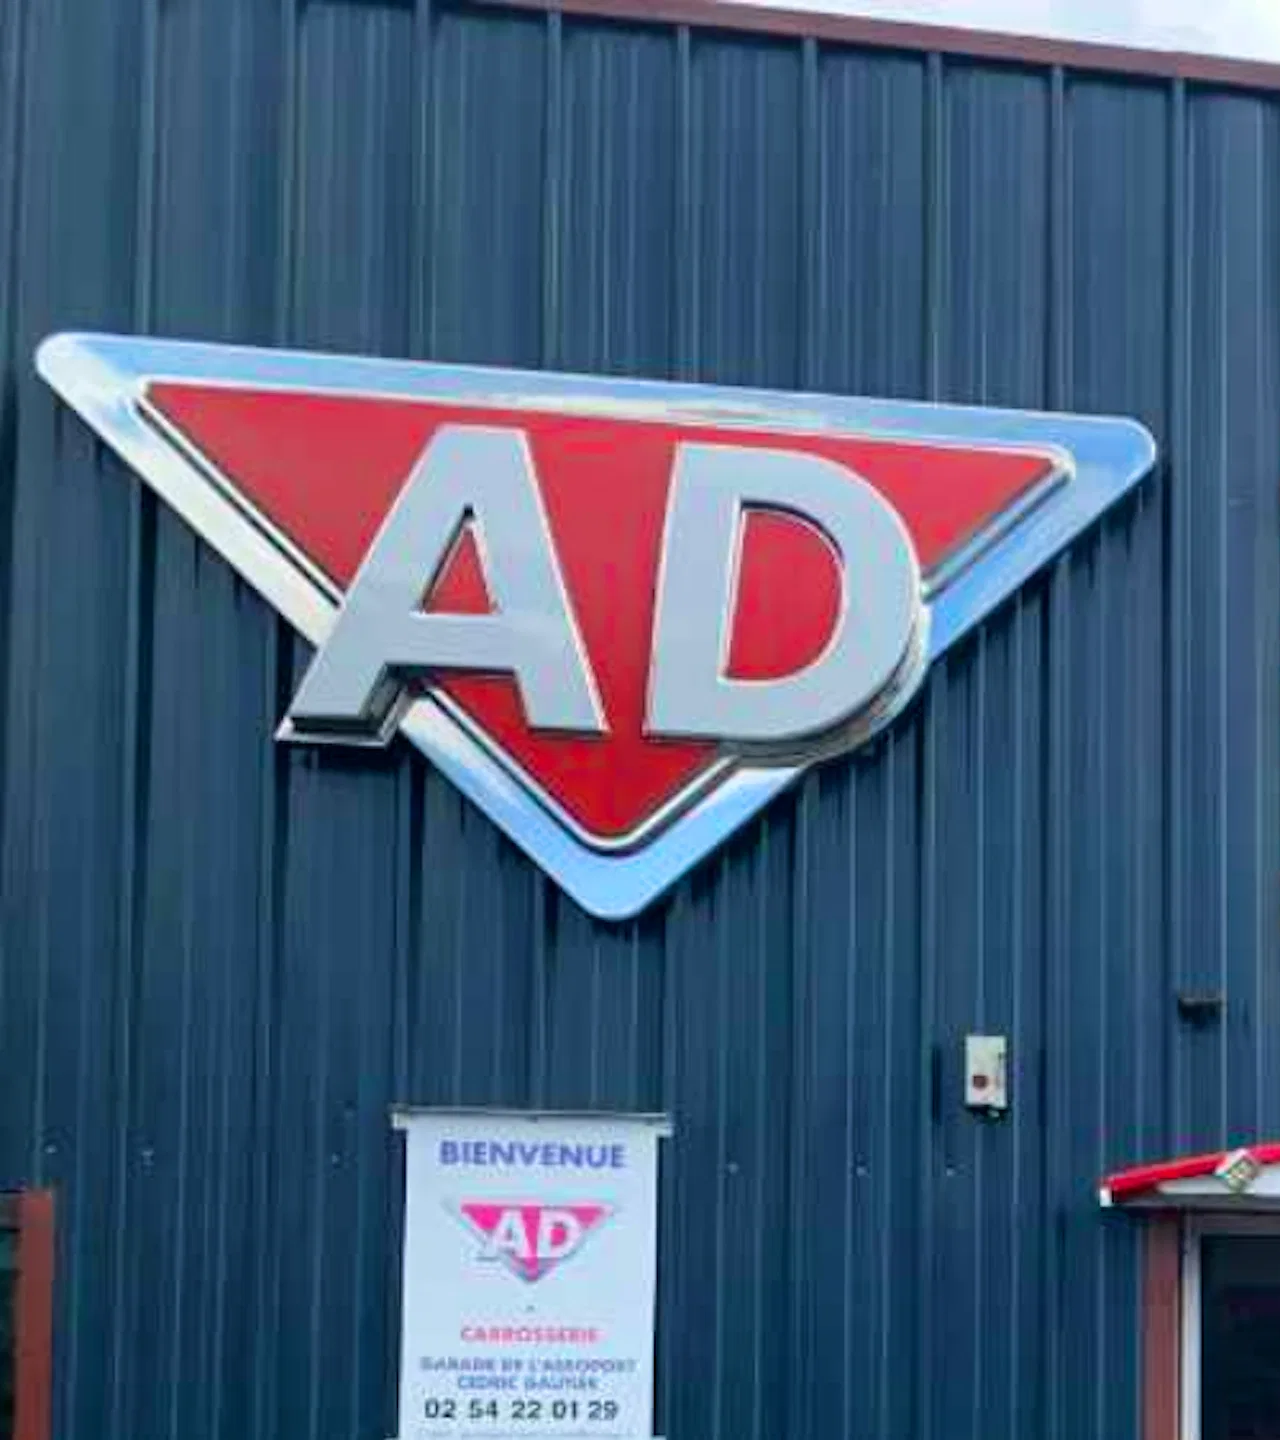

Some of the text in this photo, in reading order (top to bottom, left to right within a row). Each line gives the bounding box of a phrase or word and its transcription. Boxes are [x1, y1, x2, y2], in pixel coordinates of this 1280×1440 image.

[274, 423, 930, 766] AD
[438, 1140, 627, 1169] BIENVENUE
[477, 1207, 582, 1261] AD
[460, 1326, 600, 1343] CARROSSERIE
[424, 1399, 618, 1420] 02 54 22 01 29
